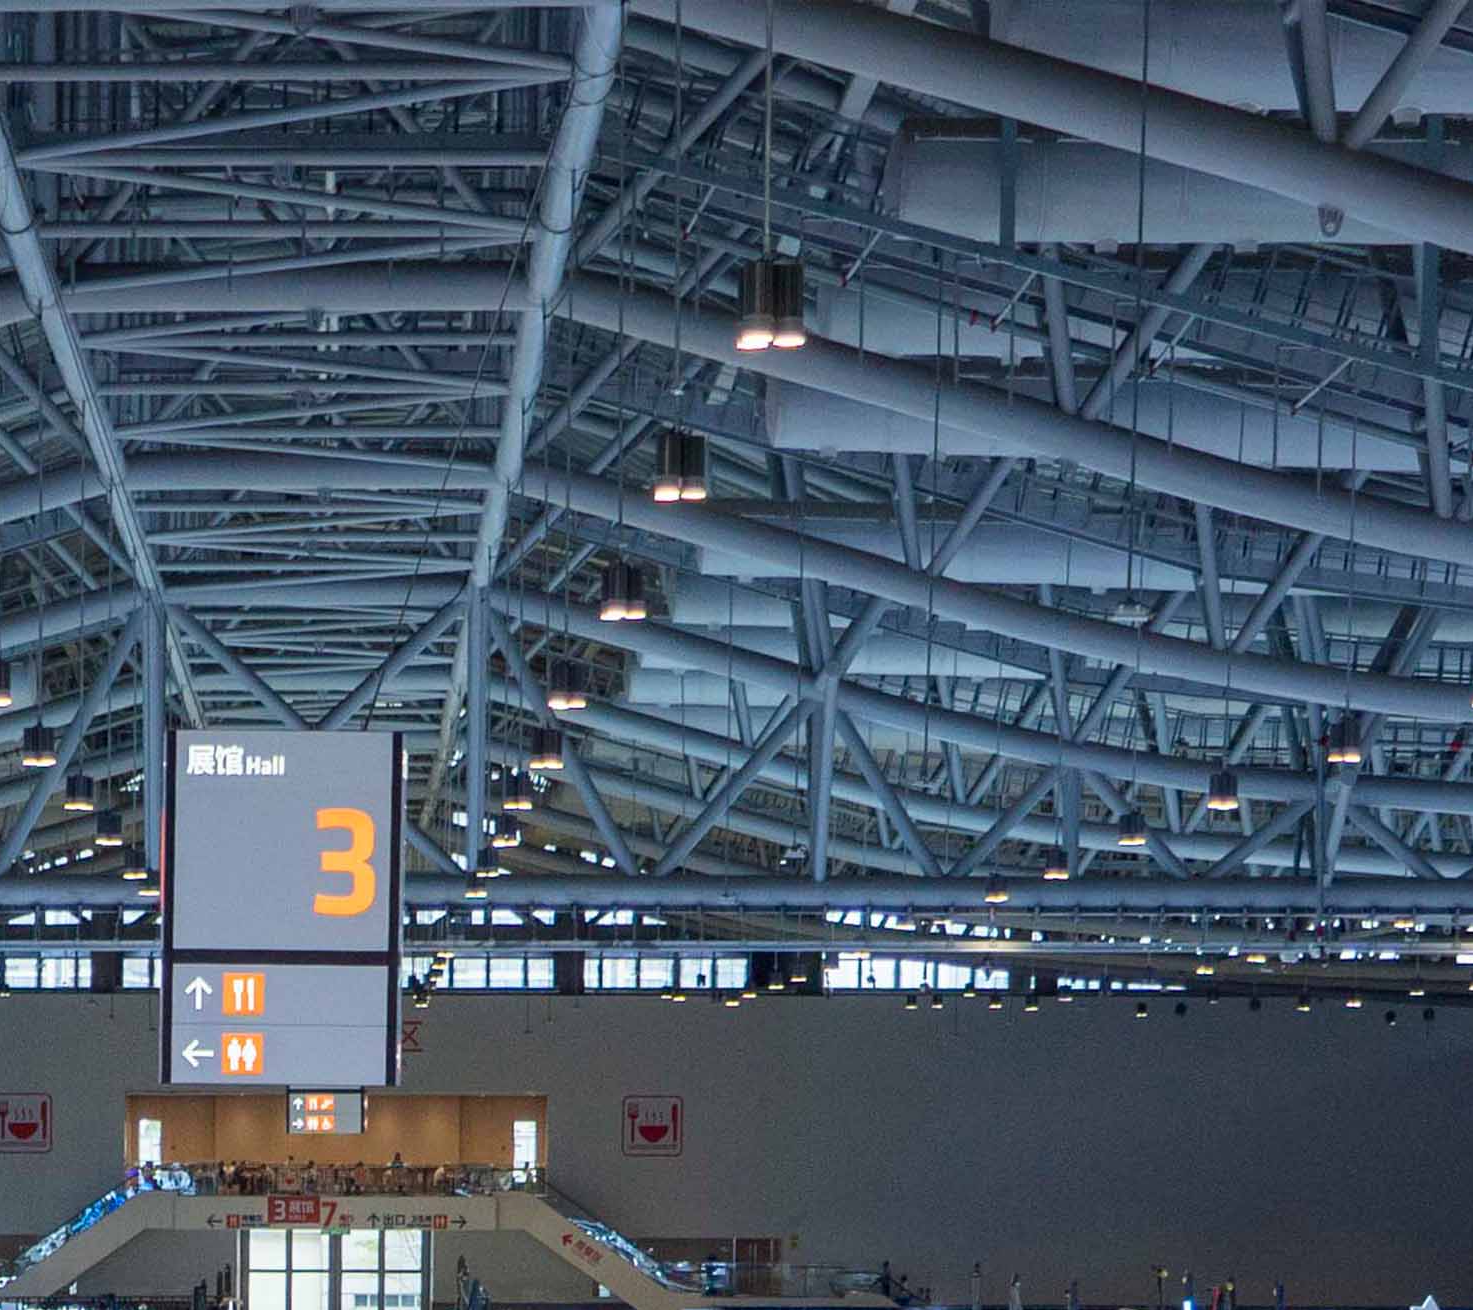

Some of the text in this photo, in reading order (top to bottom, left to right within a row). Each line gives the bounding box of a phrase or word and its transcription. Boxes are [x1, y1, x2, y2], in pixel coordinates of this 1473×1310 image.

[186, 745, 285, 776] 展馆 Hall
[313, 808, 376, 917] 3
[272, 1204, 286, 1221] 3
[320, 1201, 337, 1227] 7
